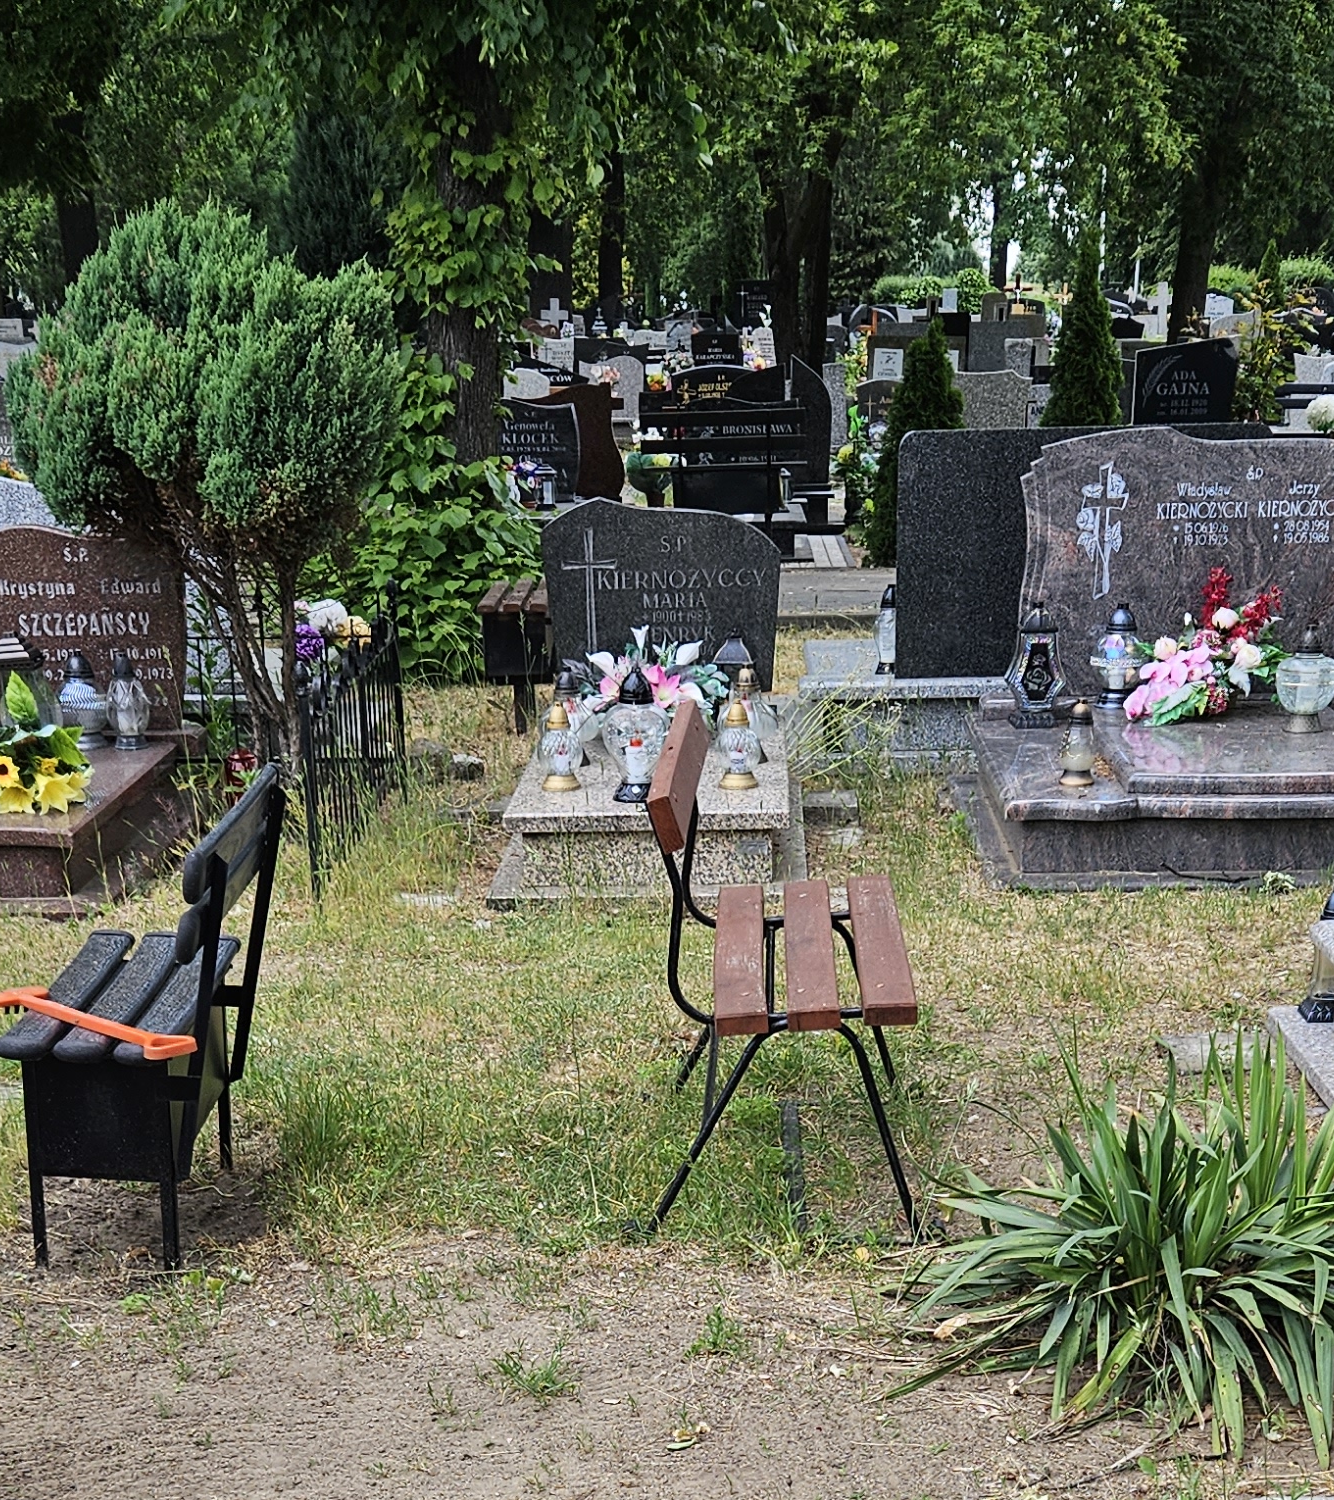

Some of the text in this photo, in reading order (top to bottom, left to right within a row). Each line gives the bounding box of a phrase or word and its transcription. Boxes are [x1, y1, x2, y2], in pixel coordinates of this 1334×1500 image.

[1172, 371, 1196, 381] ADA
[1156, 382, 1210, 395] GAJNA
[1177, 480, 1320, 500] Władysław Jerzy
[63, 543, 89, 562] Ś.P.
[99, 577, 162, 595] Edward
[643, 592, 708, 608] MARIA
